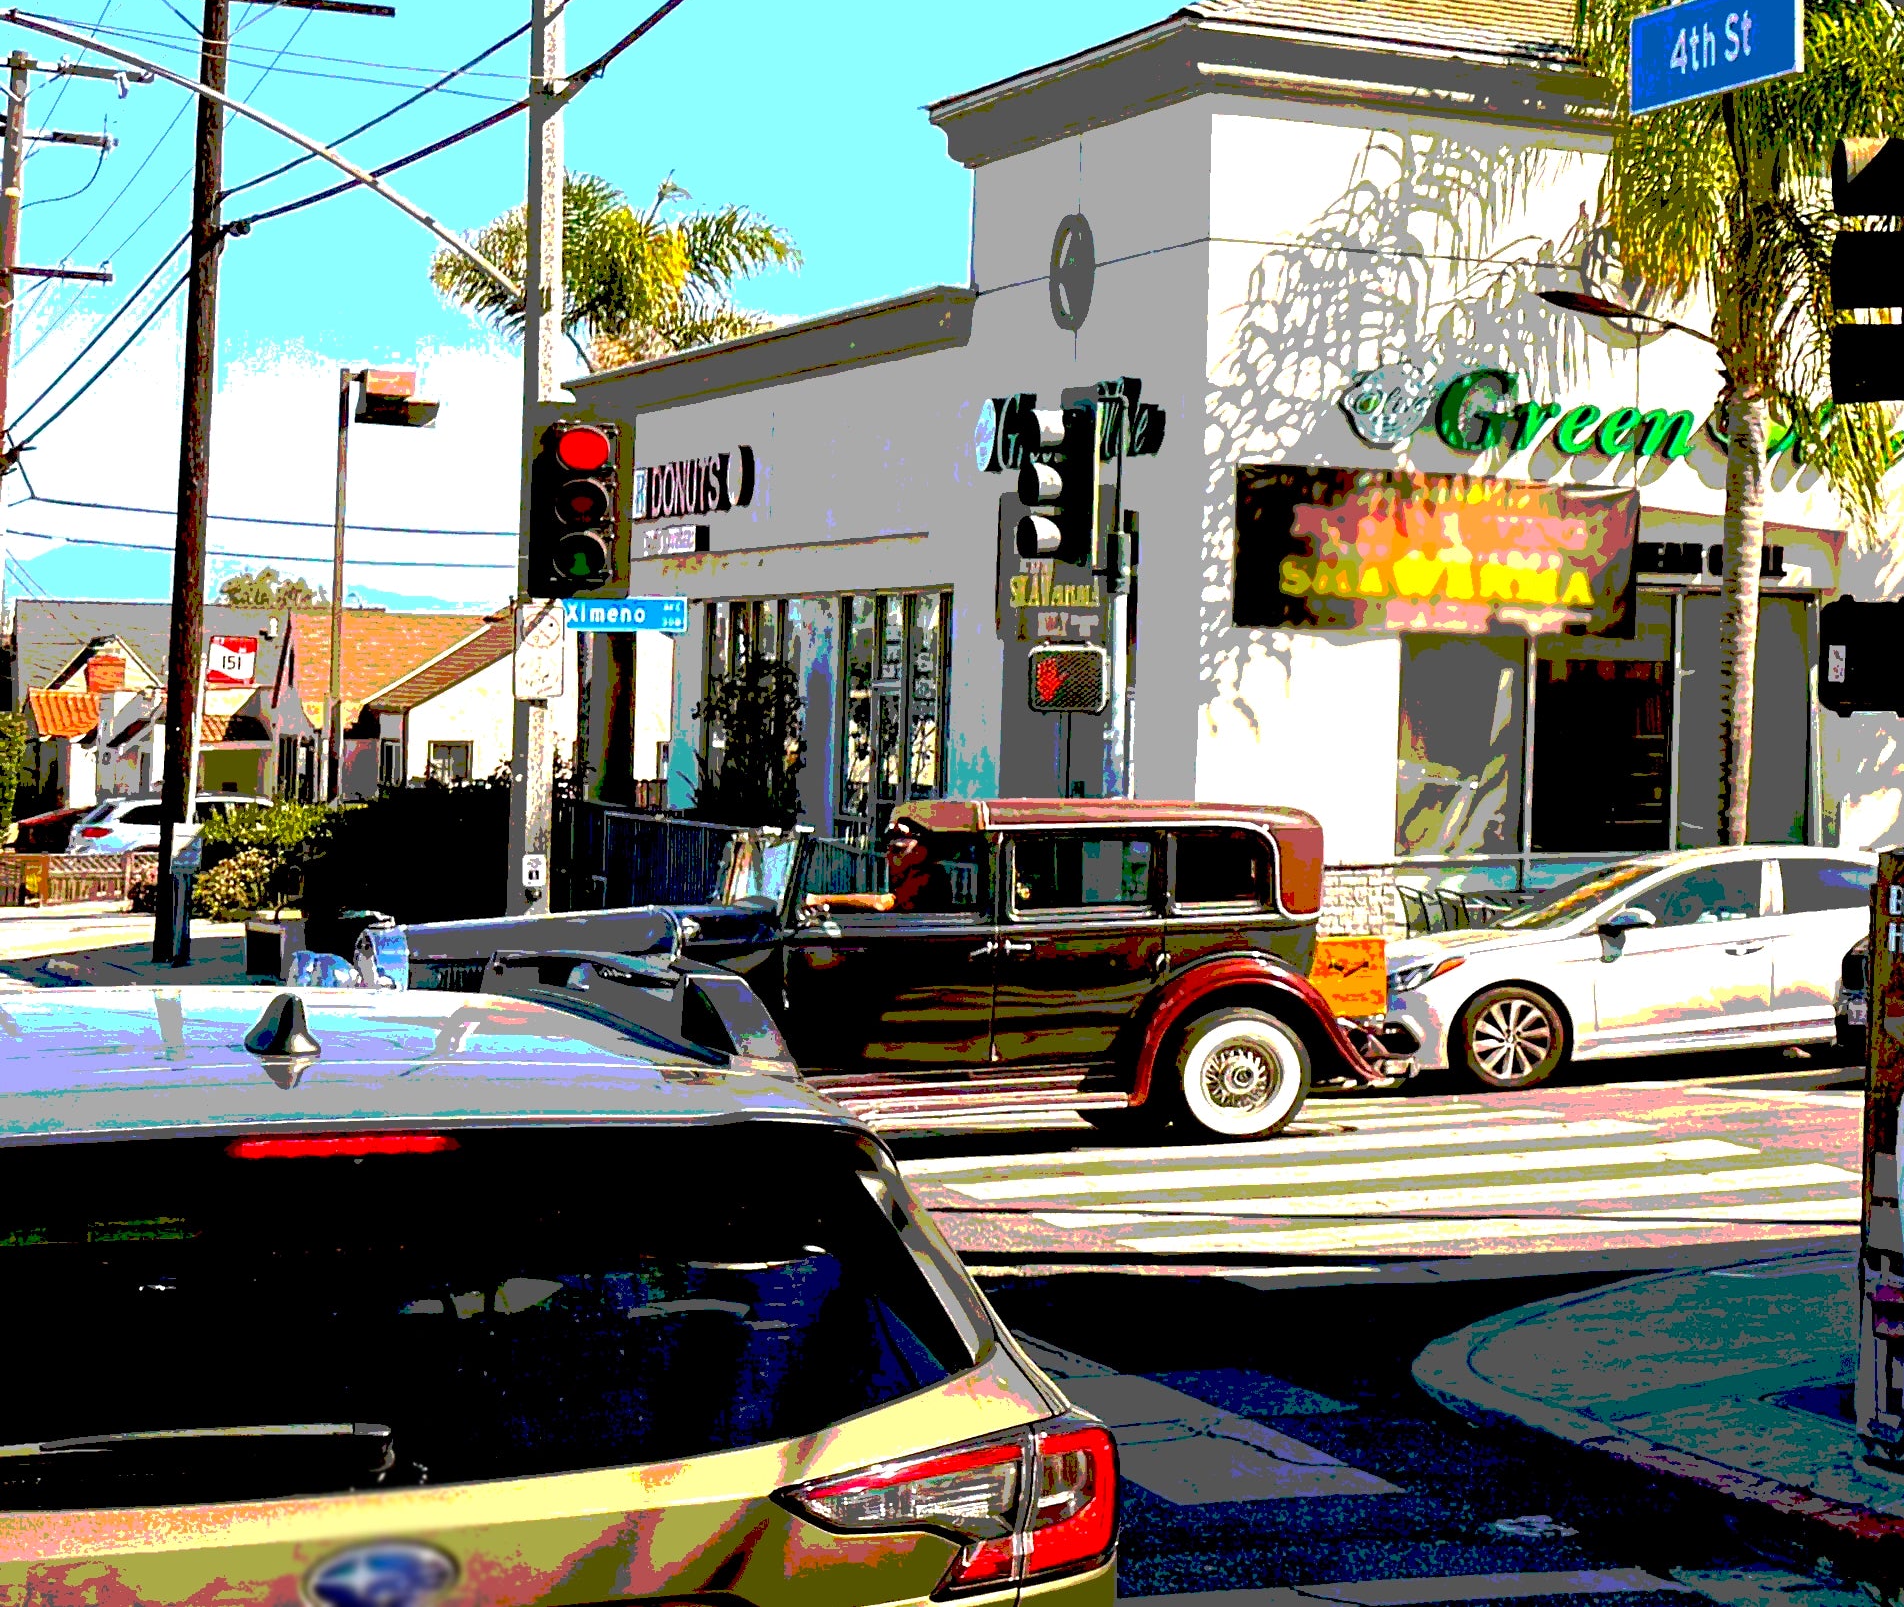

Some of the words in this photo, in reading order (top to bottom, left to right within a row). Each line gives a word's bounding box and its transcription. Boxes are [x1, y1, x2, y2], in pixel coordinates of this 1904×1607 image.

[1670, 22, 1716, 75] 4th
[1724, 9, 1752, 63] St
[1435, 368, 1696, 459] Green
[651, 457, 721, 518] DONUTS
[222, 655, 241, 670] 151
